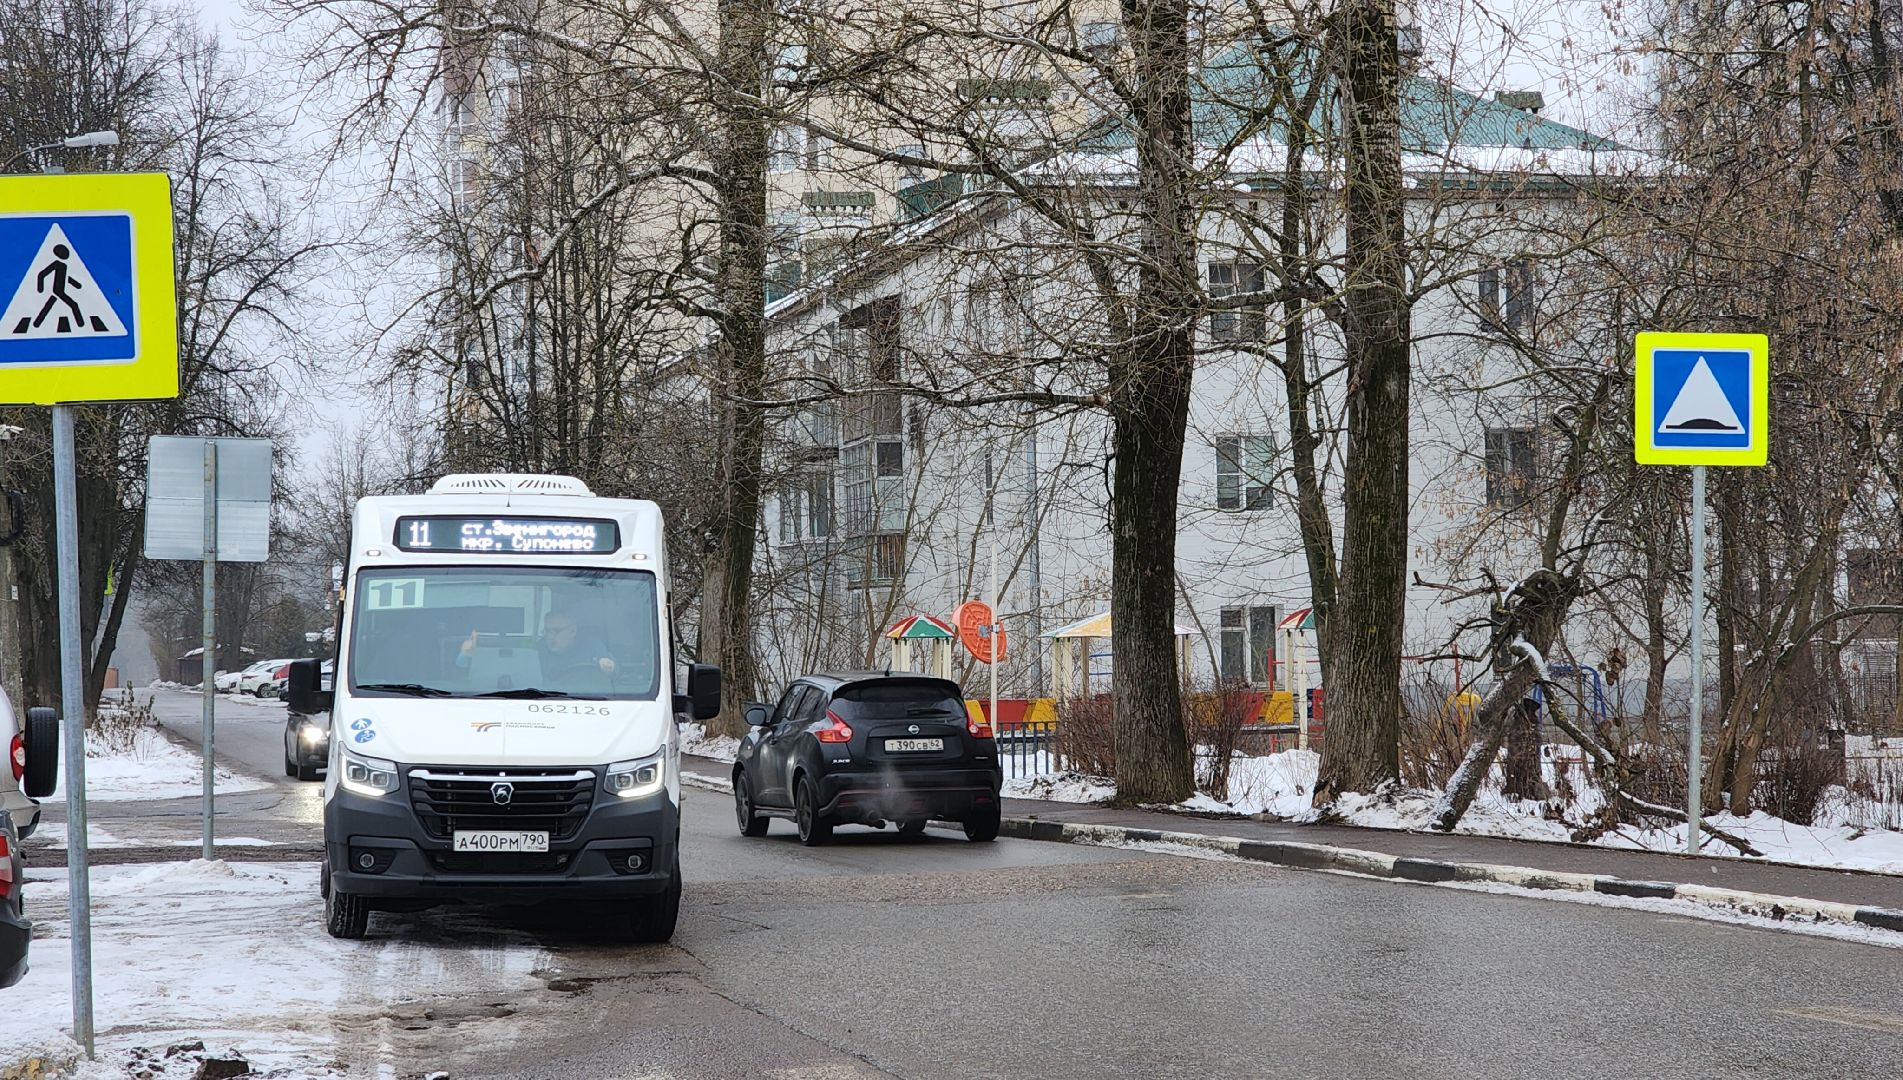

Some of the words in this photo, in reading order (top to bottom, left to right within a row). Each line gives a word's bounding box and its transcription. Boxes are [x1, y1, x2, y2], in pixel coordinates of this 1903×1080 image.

[409, 521, 431, 547] 11
[371, 581, 416, 607] 11
[528, 704, 610, 716] 062126
[522, 834, 544, 845] 790
